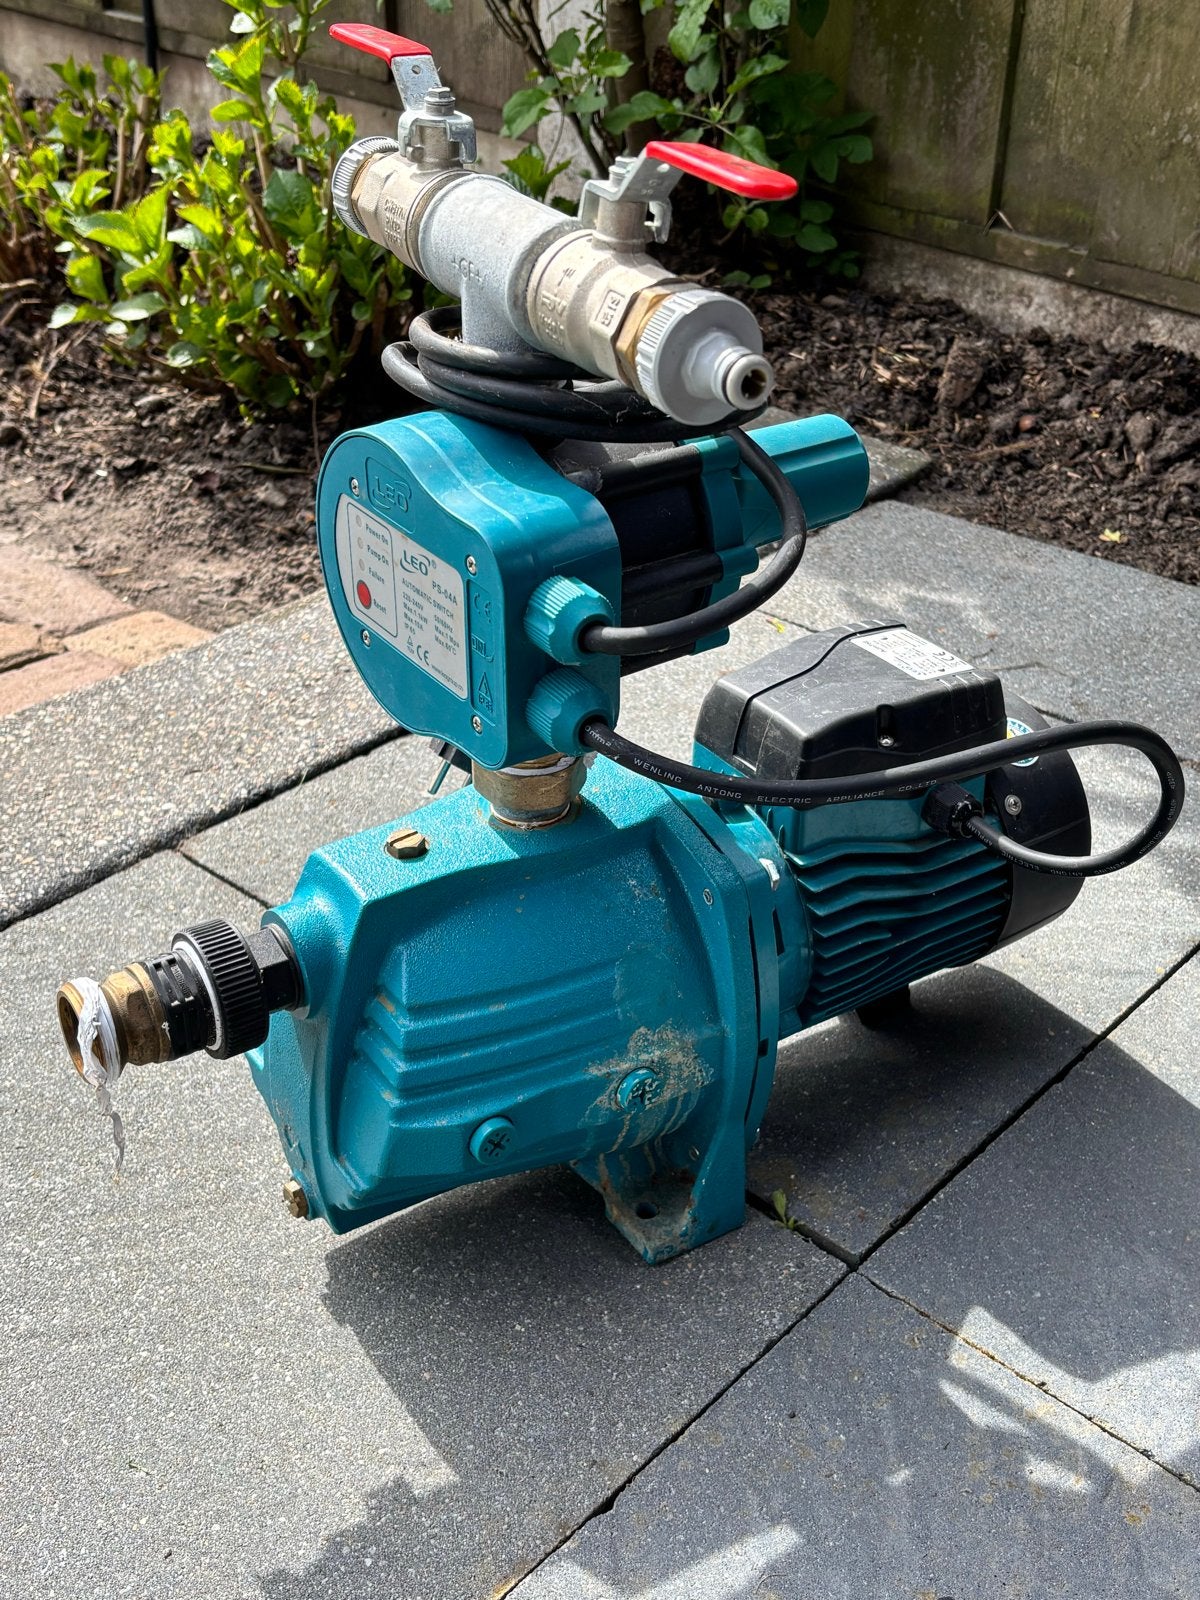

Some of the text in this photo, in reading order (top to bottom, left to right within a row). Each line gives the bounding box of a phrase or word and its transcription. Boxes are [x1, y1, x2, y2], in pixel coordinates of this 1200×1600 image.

[373, 476, 412, 513] LEO
[368, 567, 385, 585] Failure
[401, 550, 429, 577] LEO
[402, 578, 455, 620] AUTOMATIC SWITCH
[633, 758, 683, 783] WENLING
[696, 784, 743, 800] ANTONG
[756, 795, 812, 805] ELECTRIC
[826, 789, 885, 803] APPLIANCE
